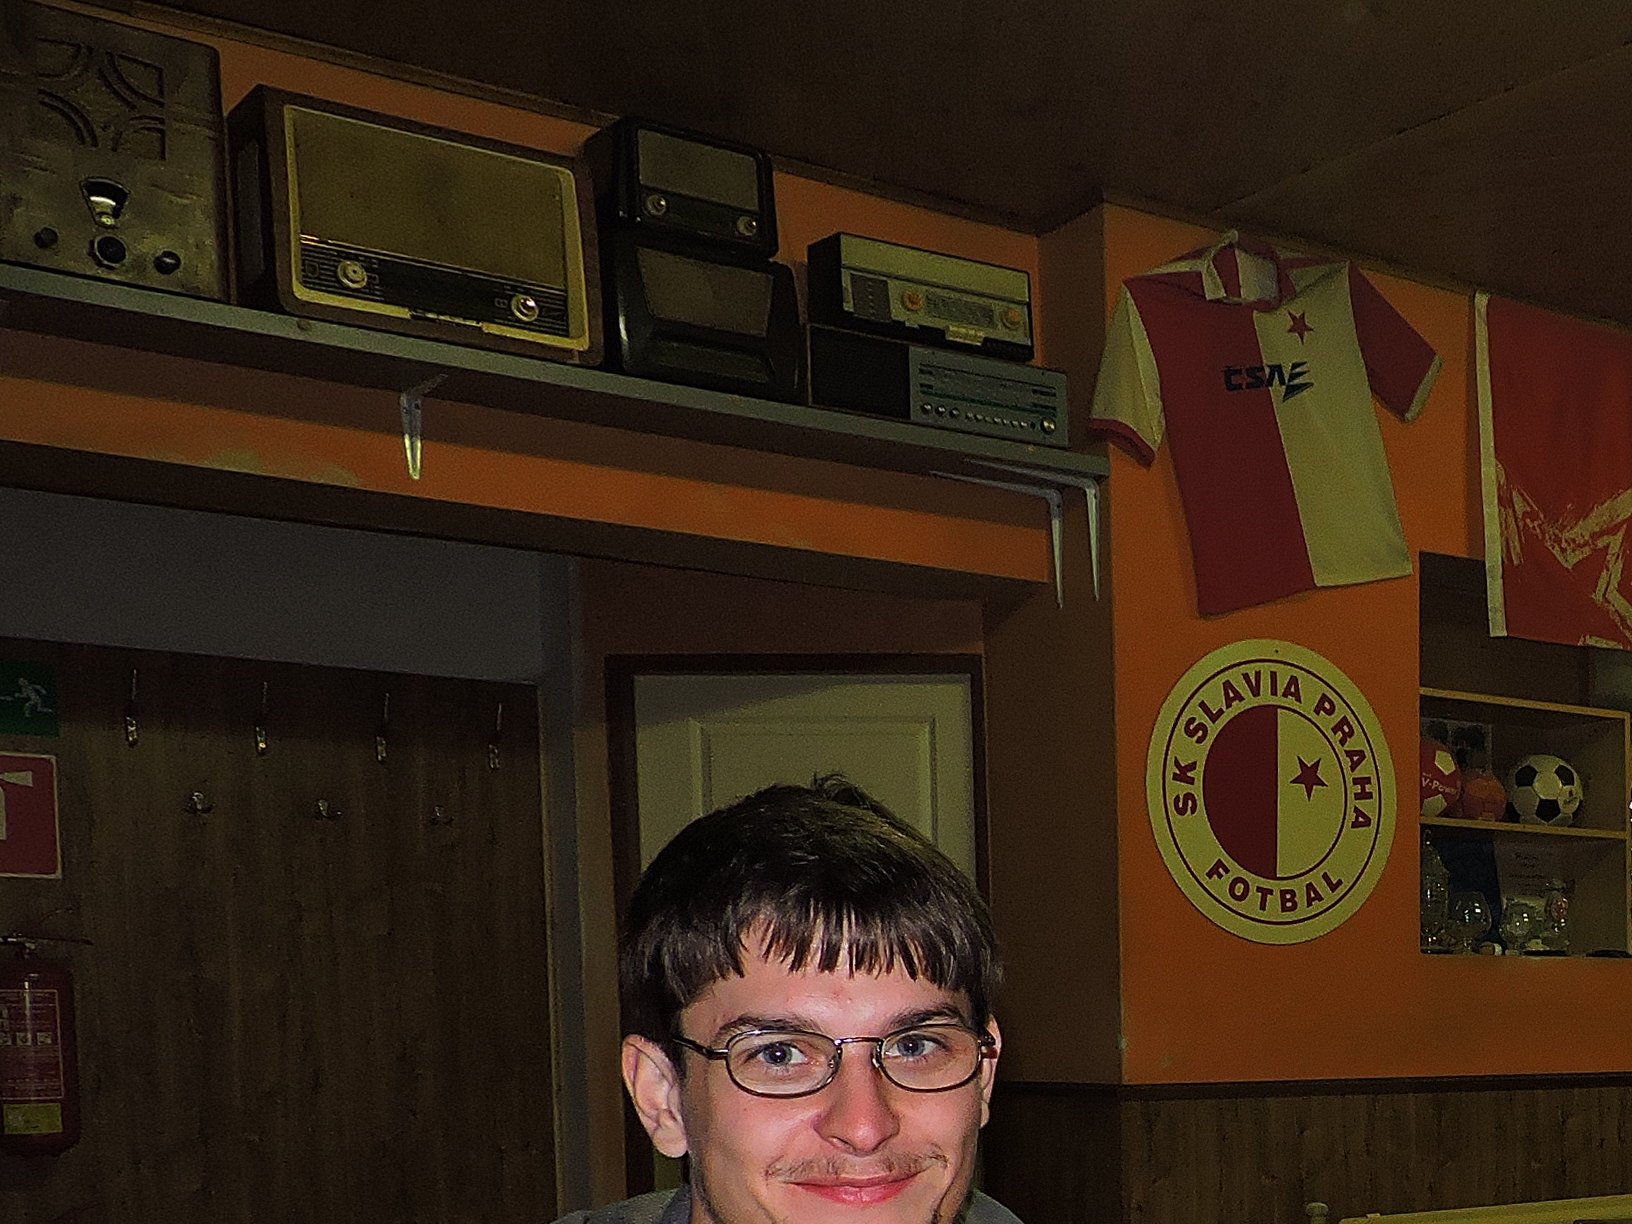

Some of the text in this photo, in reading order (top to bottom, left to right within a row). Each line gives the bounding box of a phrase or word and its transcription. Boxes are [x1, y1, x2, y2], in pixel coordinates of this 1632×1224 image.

[1172, 669, 1375, 830] SK SLAVIA PRAHA
[1205, 857, 1344, 913] FOTBAL
